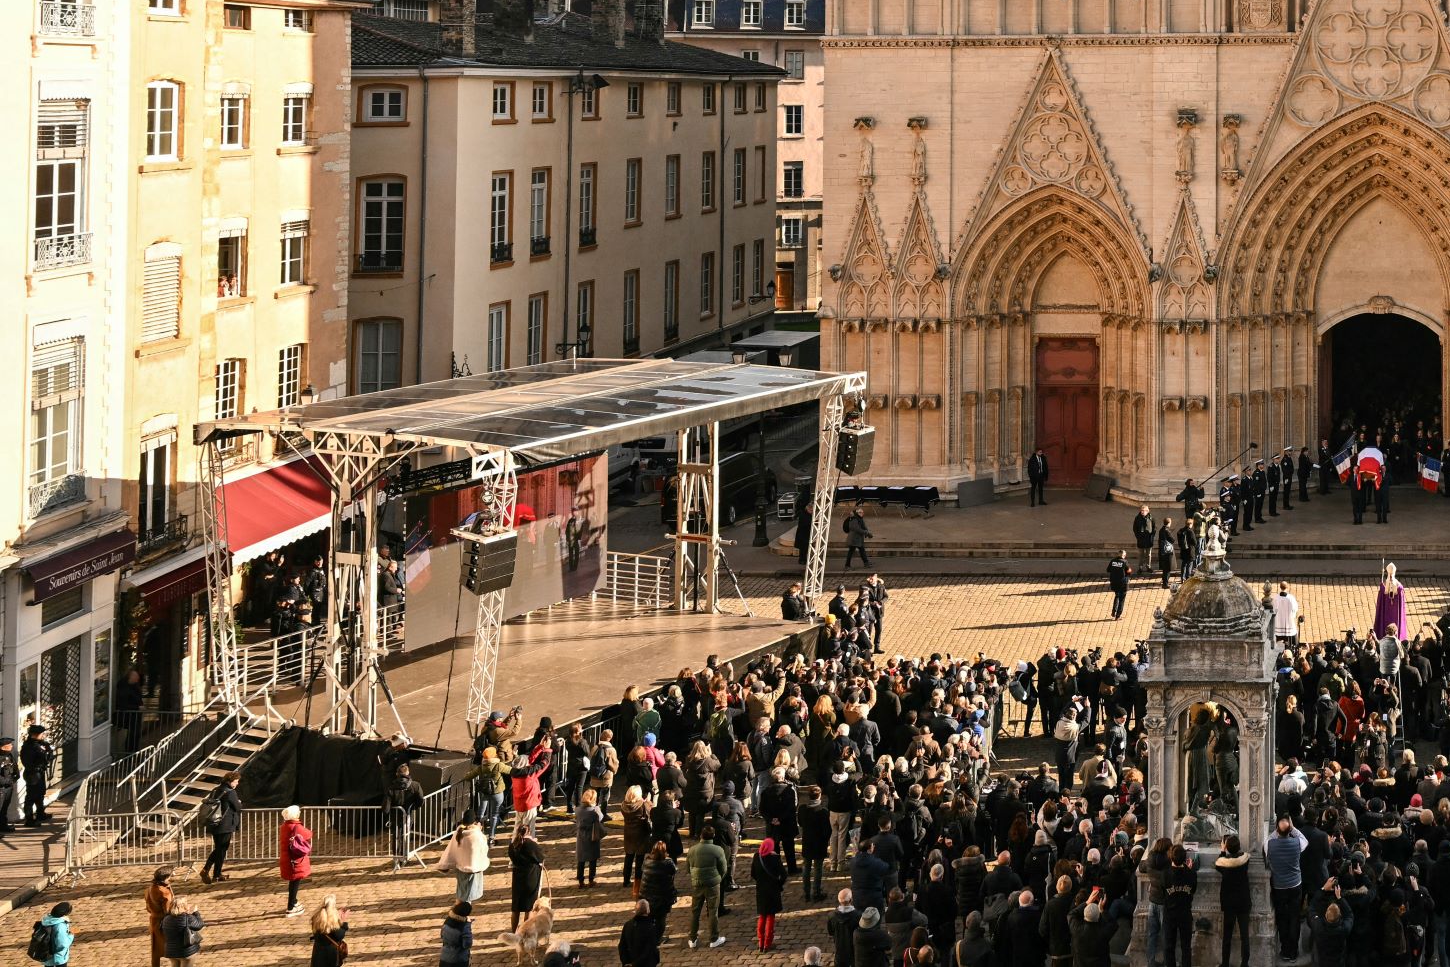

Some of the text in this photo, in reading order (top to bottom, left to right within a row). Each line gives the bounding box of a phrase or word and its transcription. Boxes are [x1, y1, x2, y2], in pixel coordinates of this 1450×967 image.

[48, 570, 81, 590] Souvenirs
[81, 564, 91, 576] de
[90, 558, 108, 573] Saint
[108, 552, 124, 566] Jean
